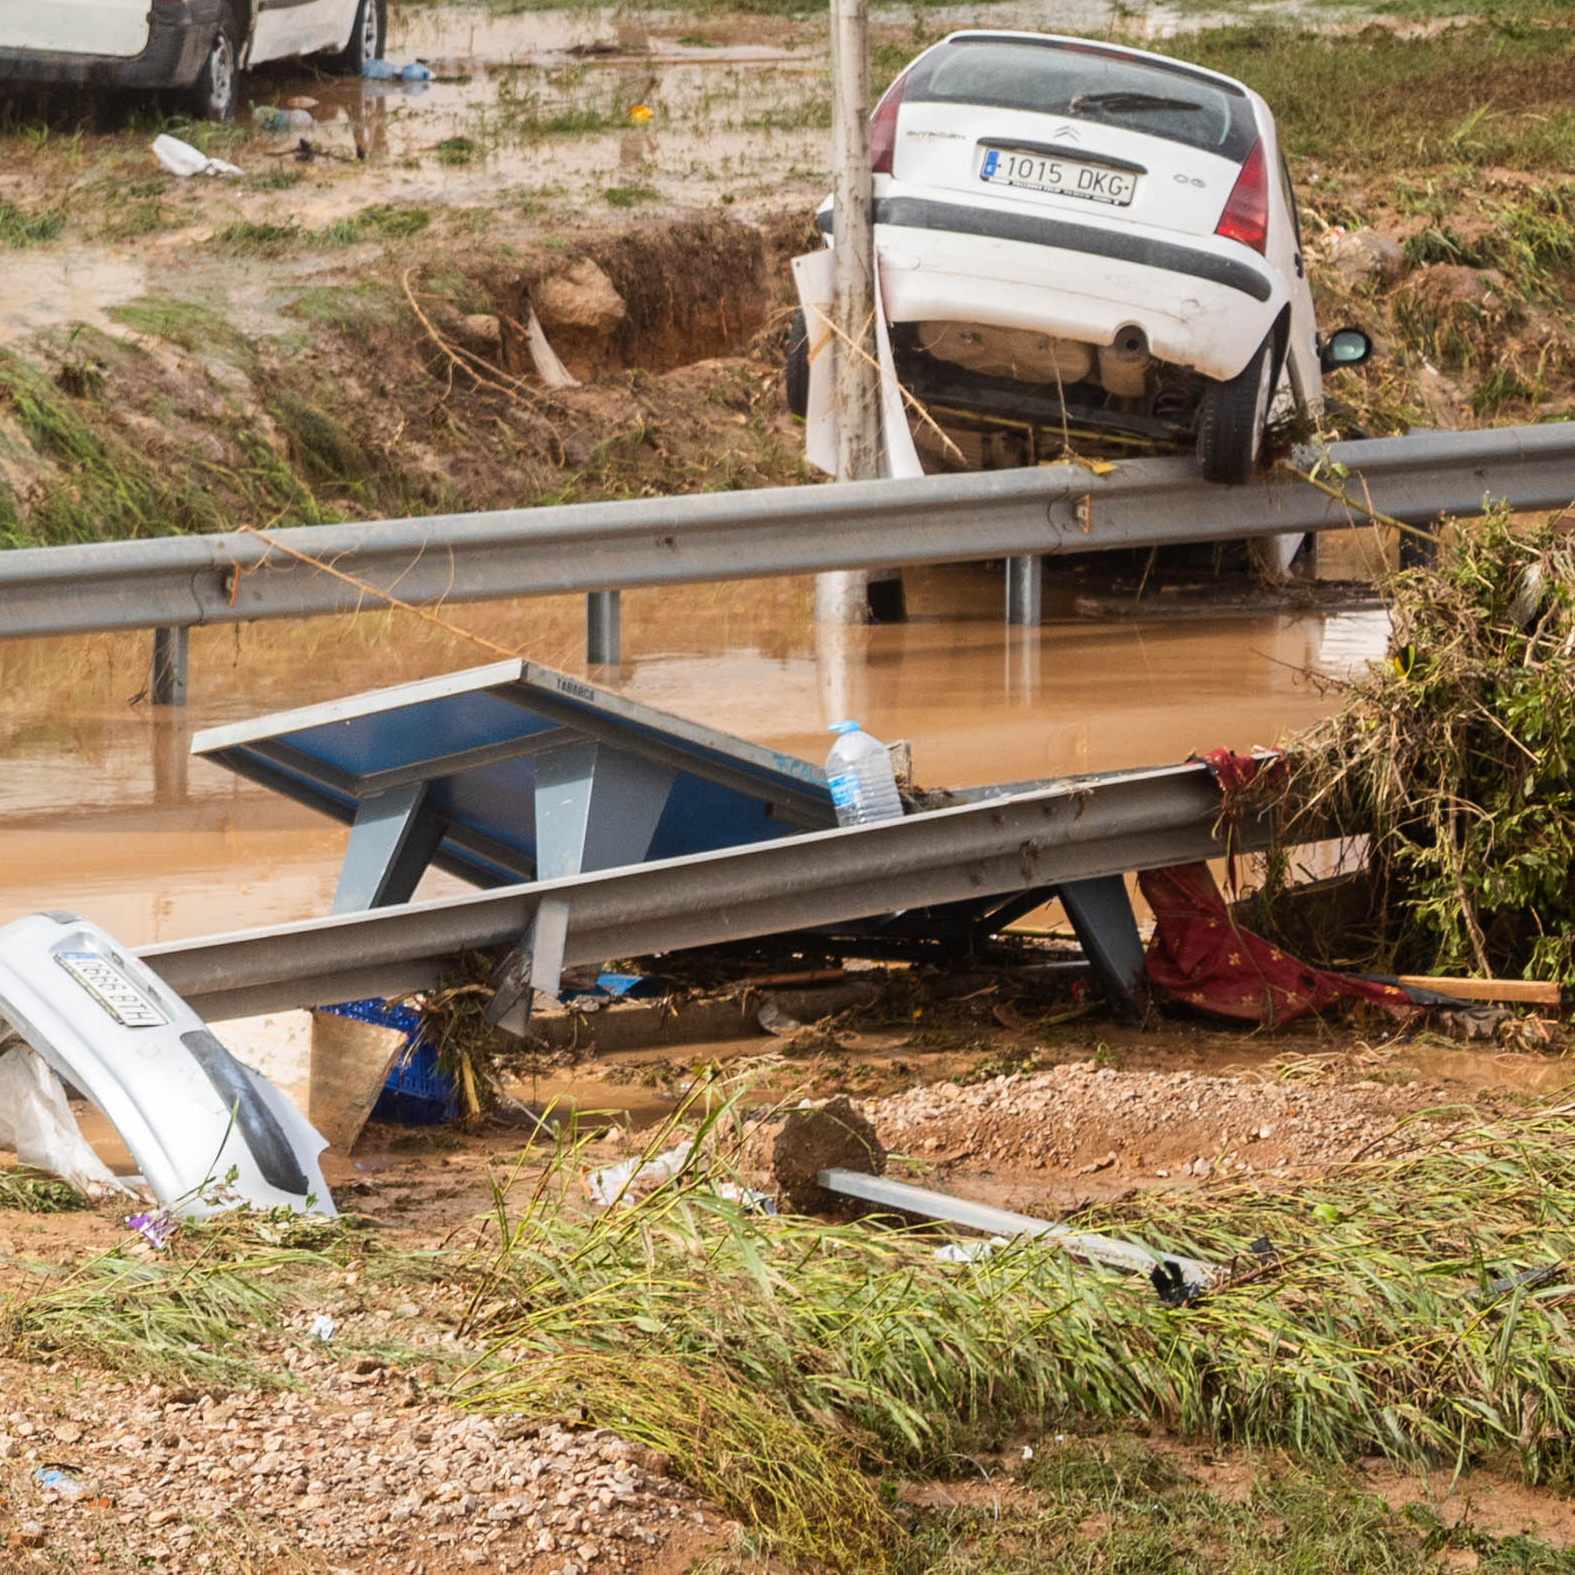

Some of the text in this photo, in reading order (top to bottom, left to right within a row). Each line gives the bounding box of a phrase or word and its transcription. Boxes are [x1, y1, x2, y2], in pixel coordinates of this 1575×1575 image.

[1008, 156, 1063, 184] 1015
[1076, 168, 1125, 196] DKG
[556, 677, 595, 702] TABARCA
